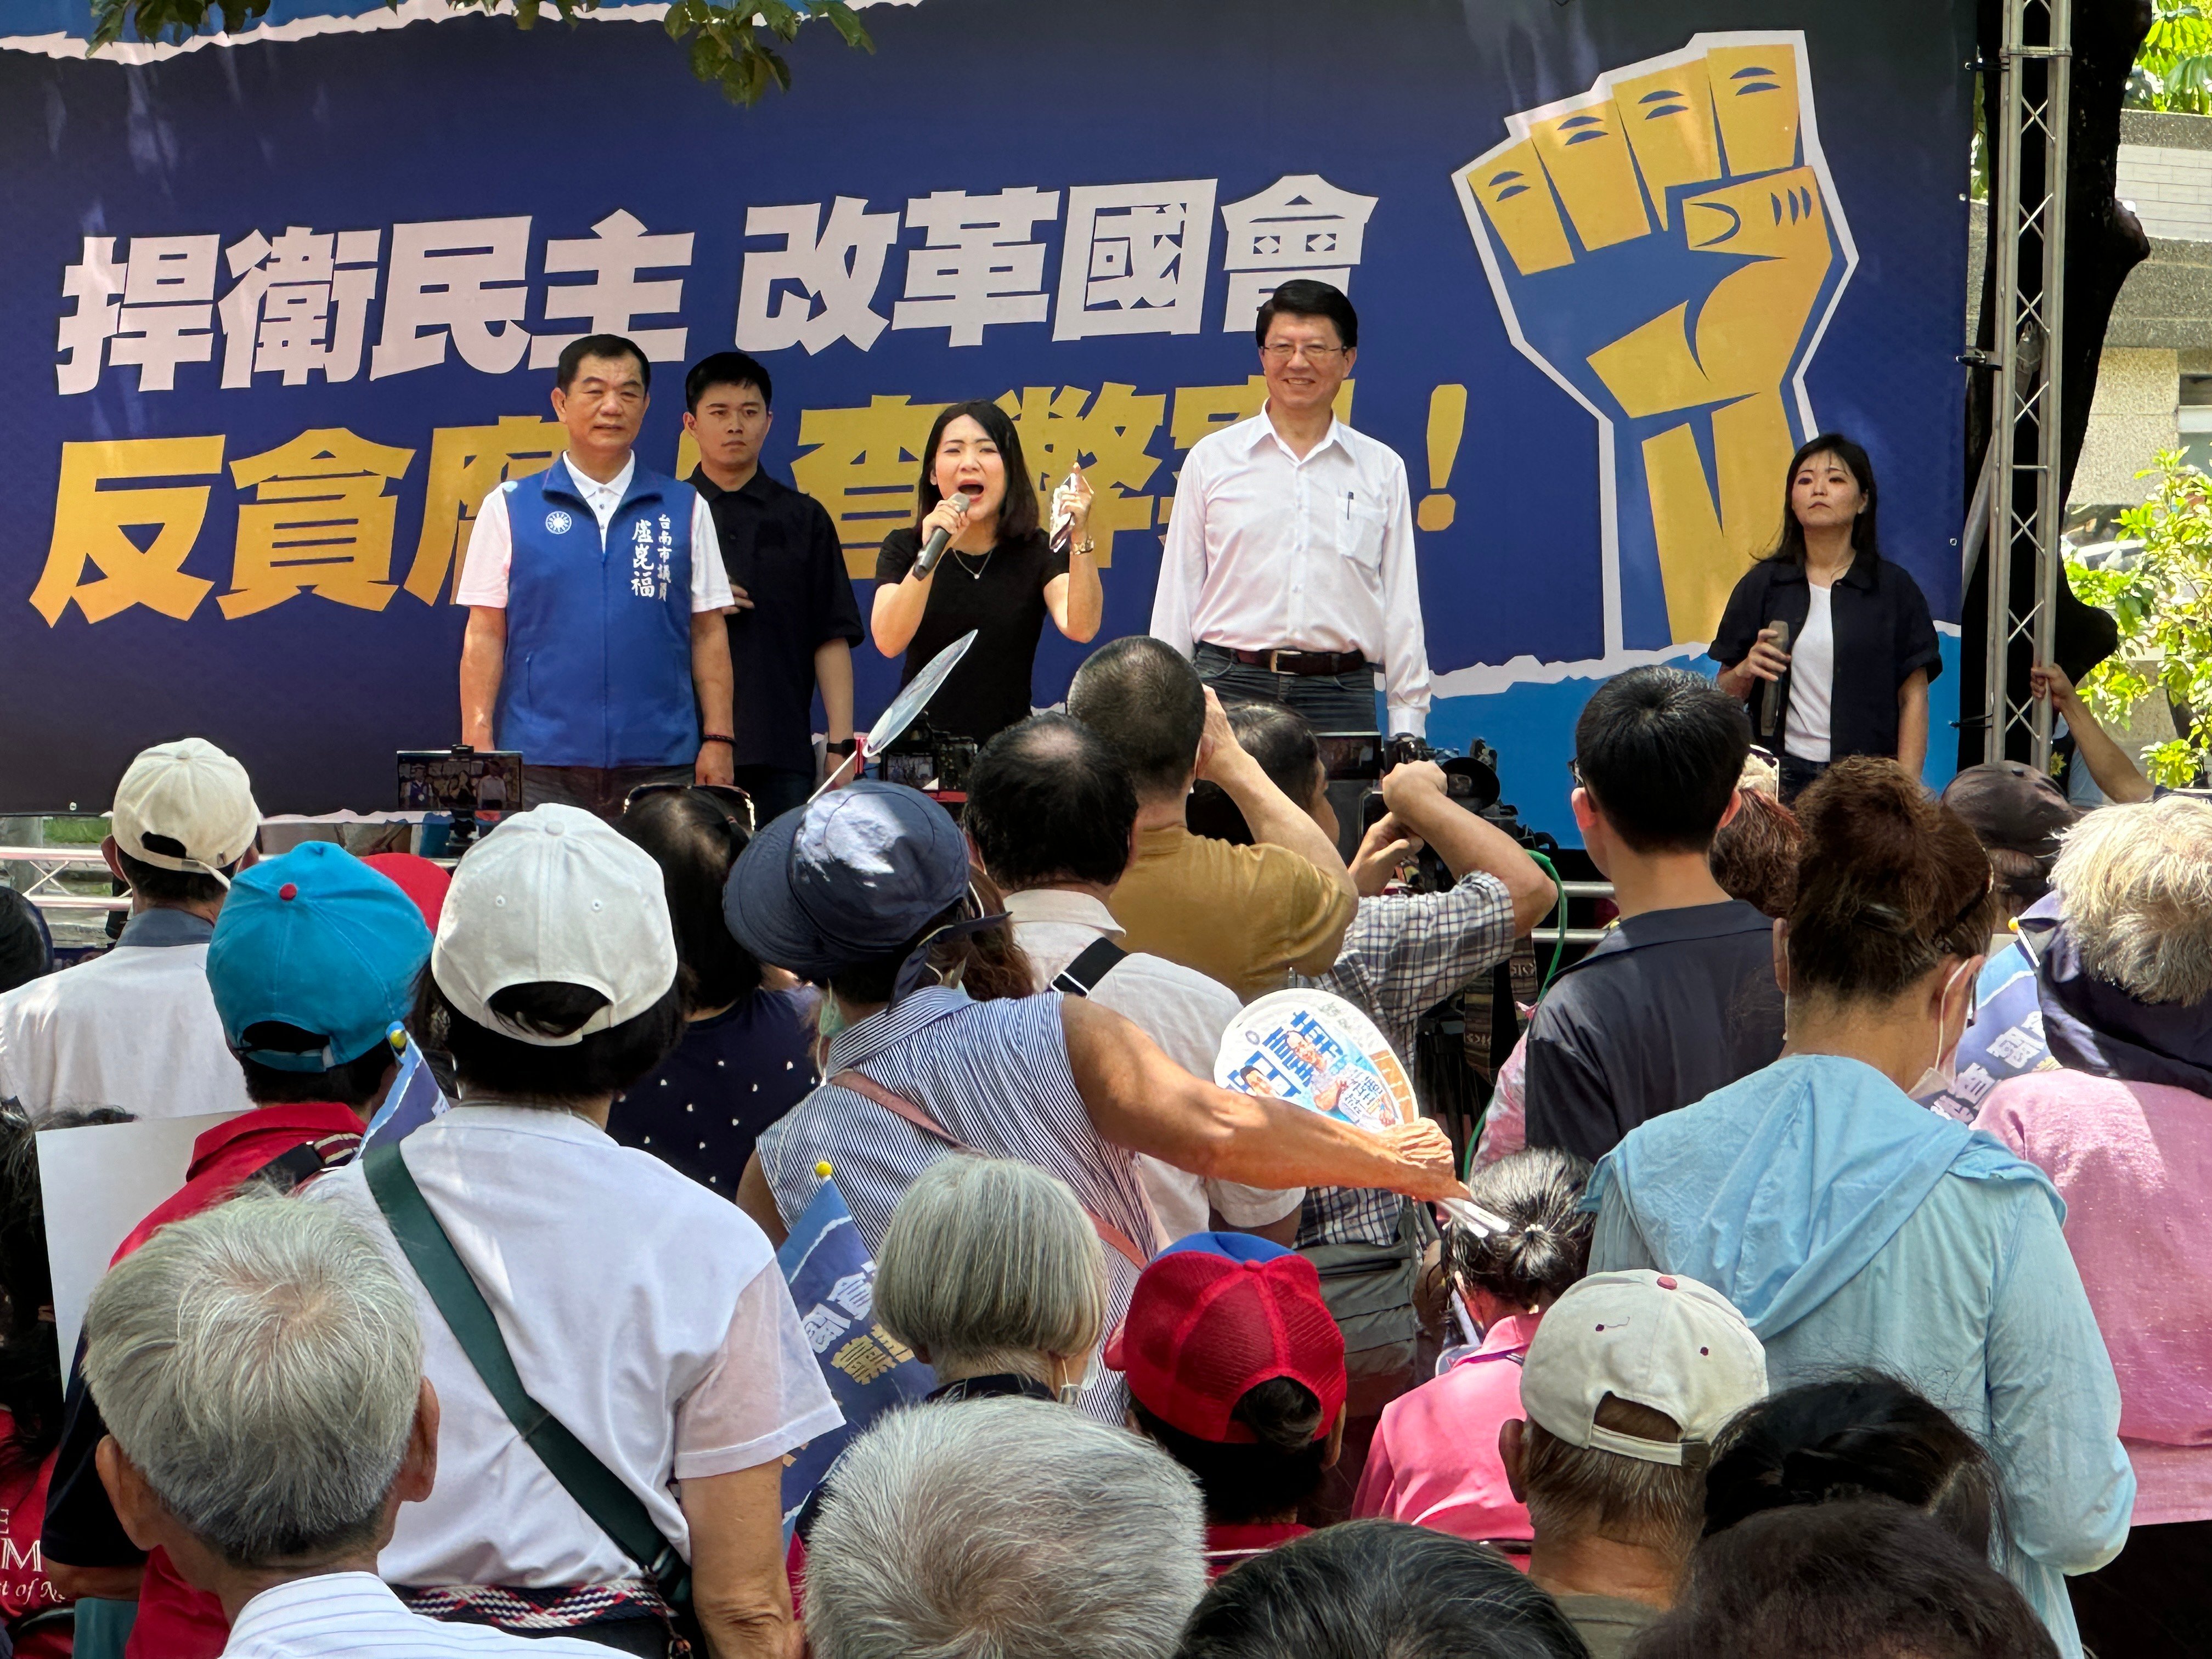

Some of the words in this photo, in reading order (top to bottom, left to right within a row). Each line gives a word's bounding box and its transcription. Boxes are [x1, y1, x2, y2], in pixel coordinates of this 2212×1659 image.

[57, 208, 694, 395] 捍衛民主
[735, 174, 1379, 356] 改革國會
[15, 1578, 39, 1605] of
